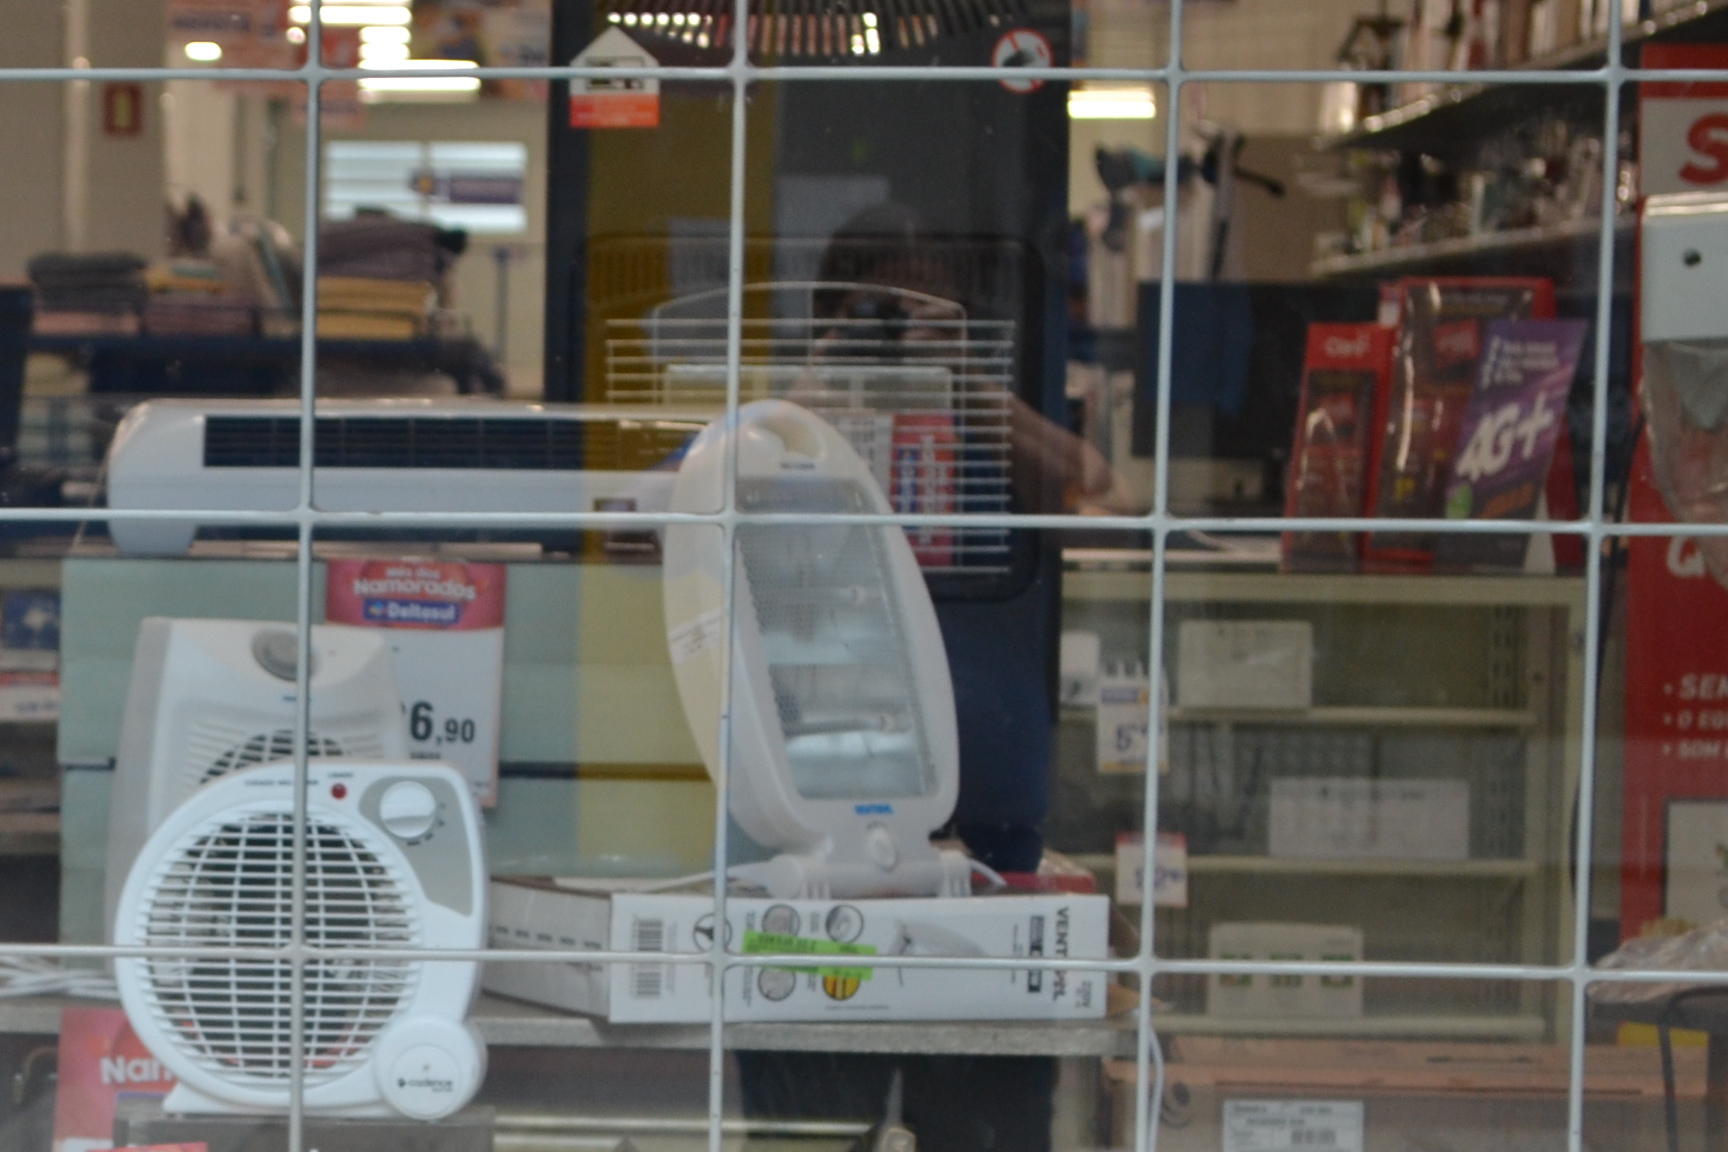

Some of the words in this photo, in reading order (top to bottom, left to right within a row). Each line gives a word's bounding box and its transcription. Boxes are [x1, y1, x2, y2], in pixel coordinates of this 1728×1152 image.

[353, 579, 476, 600] Namorados
[387, 602, 456, 619] Deltasul
[400, 700, 476, 745] 6,90
[407, 1077, 454, 1089] cadence
